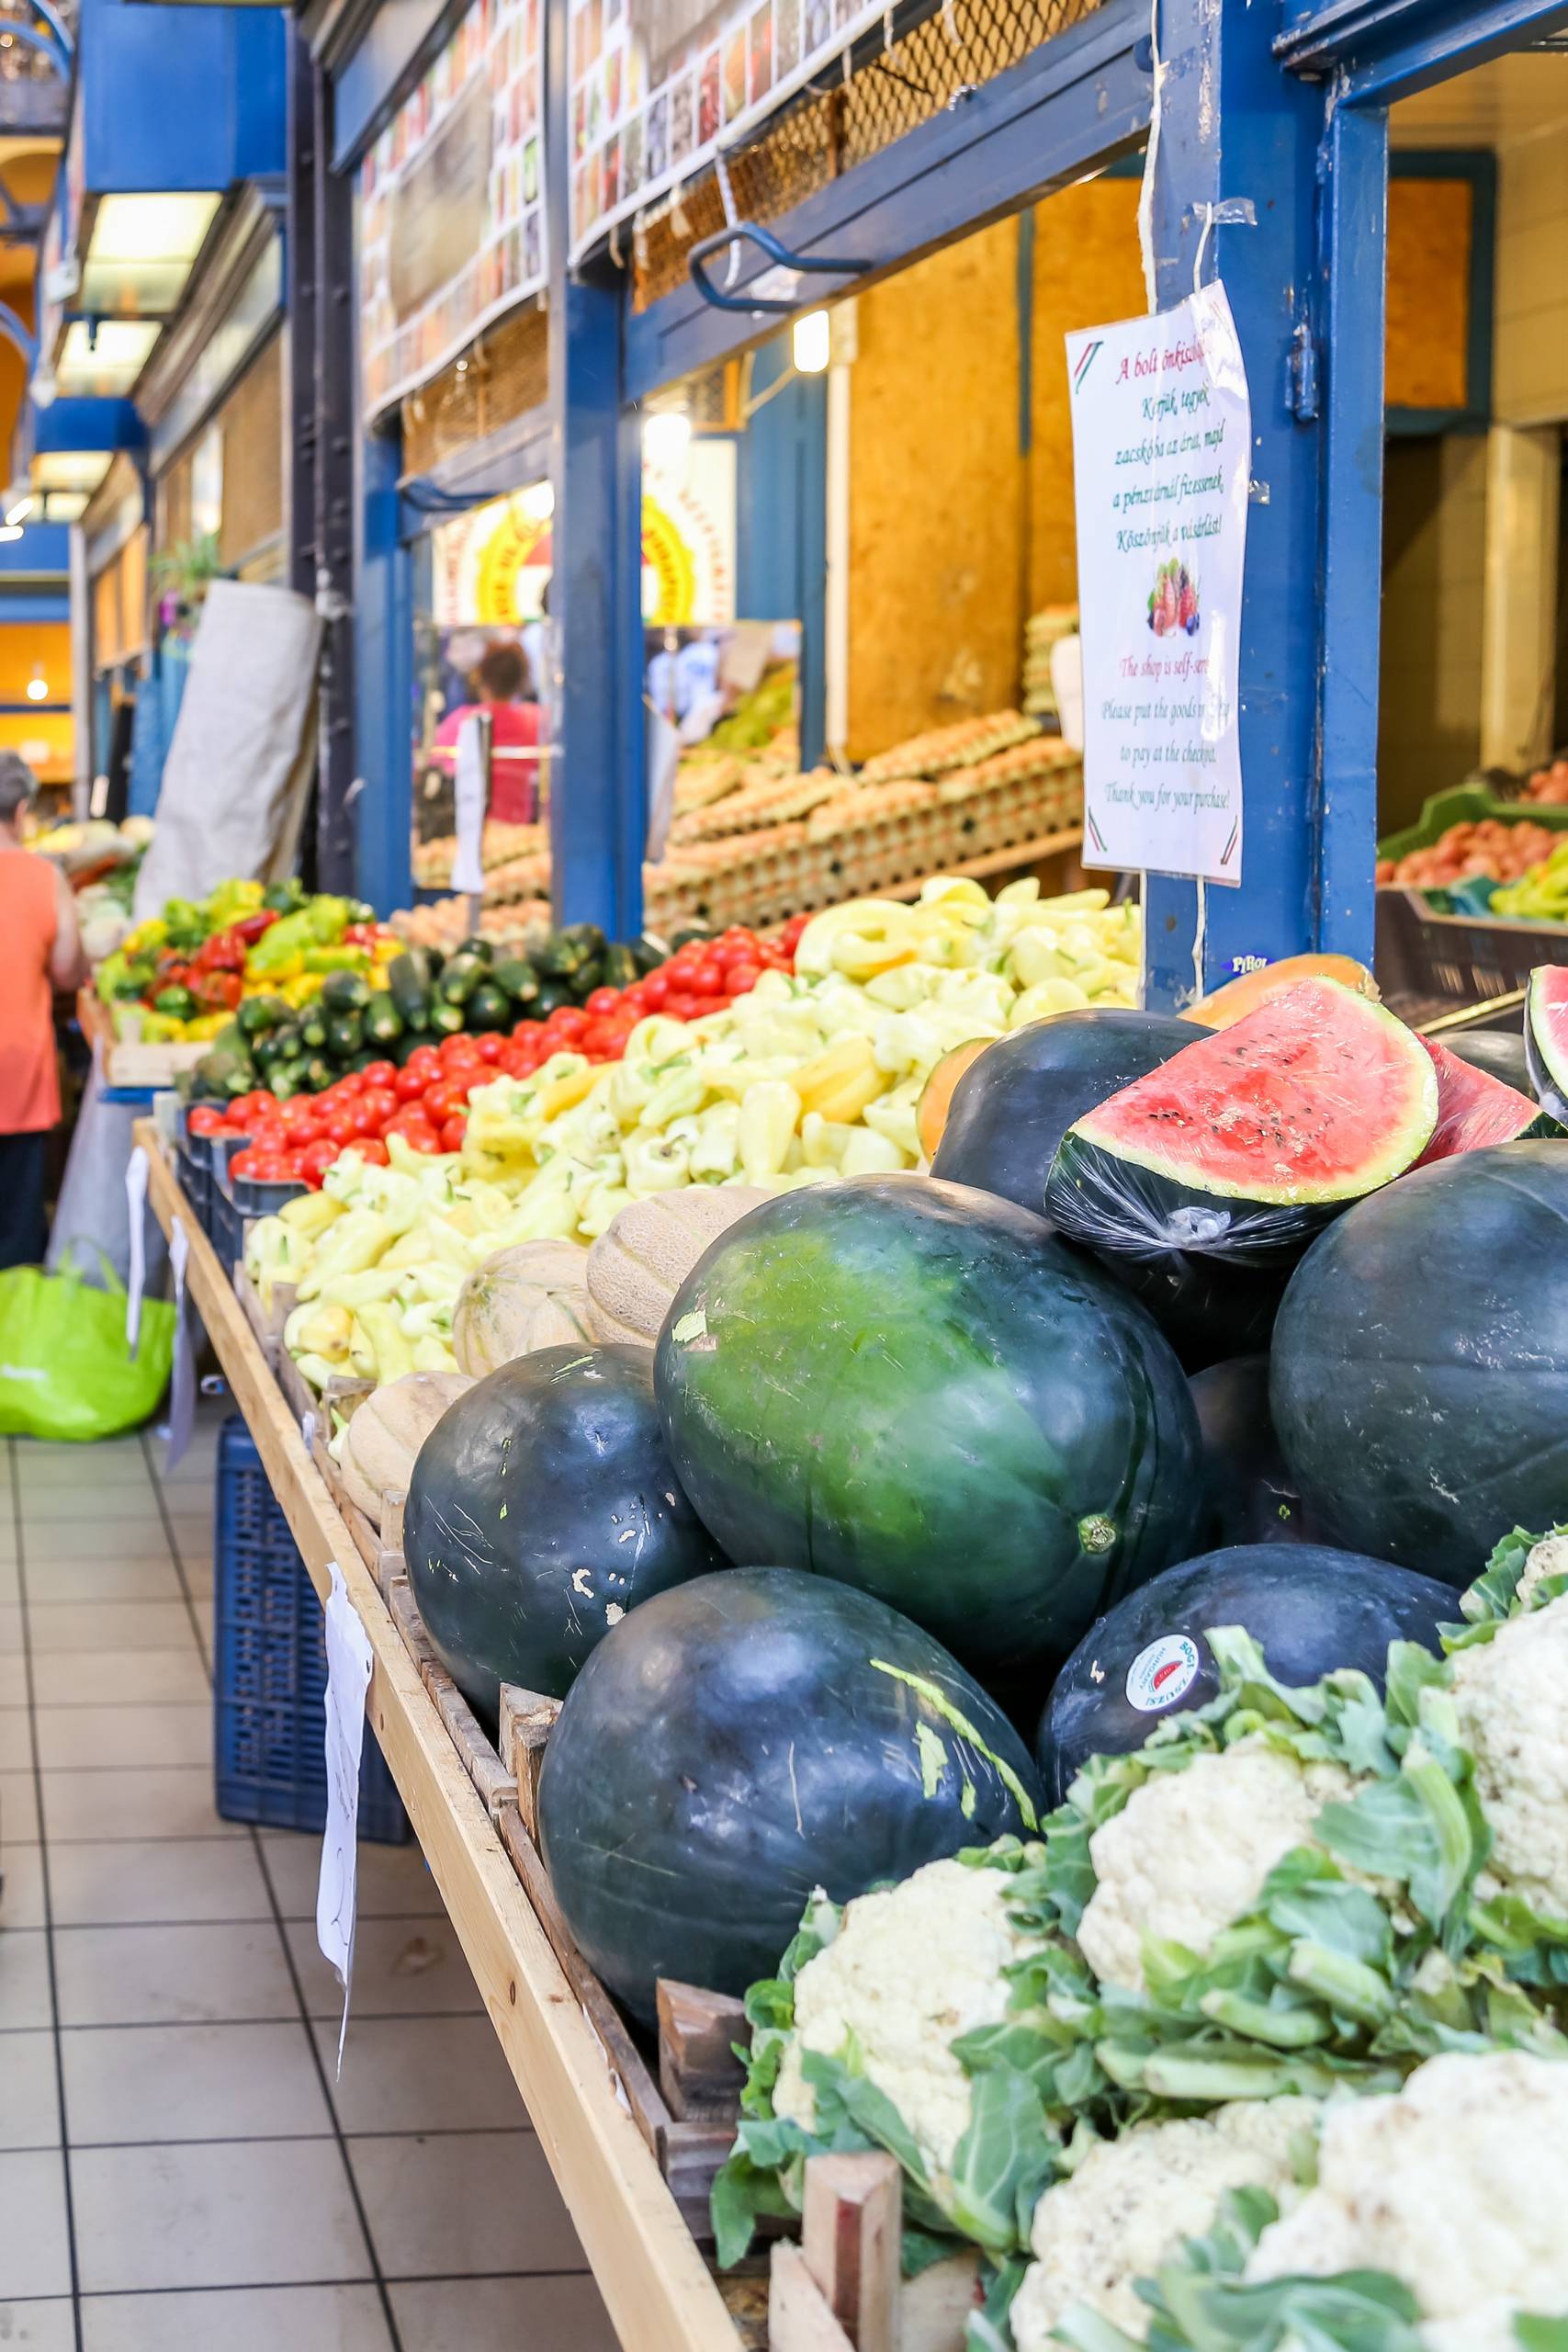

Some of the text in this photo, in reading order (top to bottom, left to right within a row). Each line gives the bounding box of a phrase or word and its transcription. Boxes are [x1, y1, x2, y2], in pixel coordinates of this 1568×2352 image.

[1115, 357, 1129, 384] A
[1134, 348, 1157, 378] bolt
[1204, 418, 1225, 452] majd
[1112, 493, 1120, 508] a
[1172, 527, 1179, 541] a
[1121, 654, 1138, 677] The
[1141, 653, 1163, 683] shop
[1164, 655, 1172, 675] is
[1102, 698, 1132, 719] Please
[1133, 703, 1151, 726] put
[1154, 696, 1168, 718] the
[1169, 695, 1196, 726] goods
[1120, 746, 1131, 762] to
[1131, 747, 1150, 768] pay
[1152, 746, 1163, 762] at
[1166, 739, 1180, 762] the
[1105, 781, 1231, 815] Thank you for your purchase!
